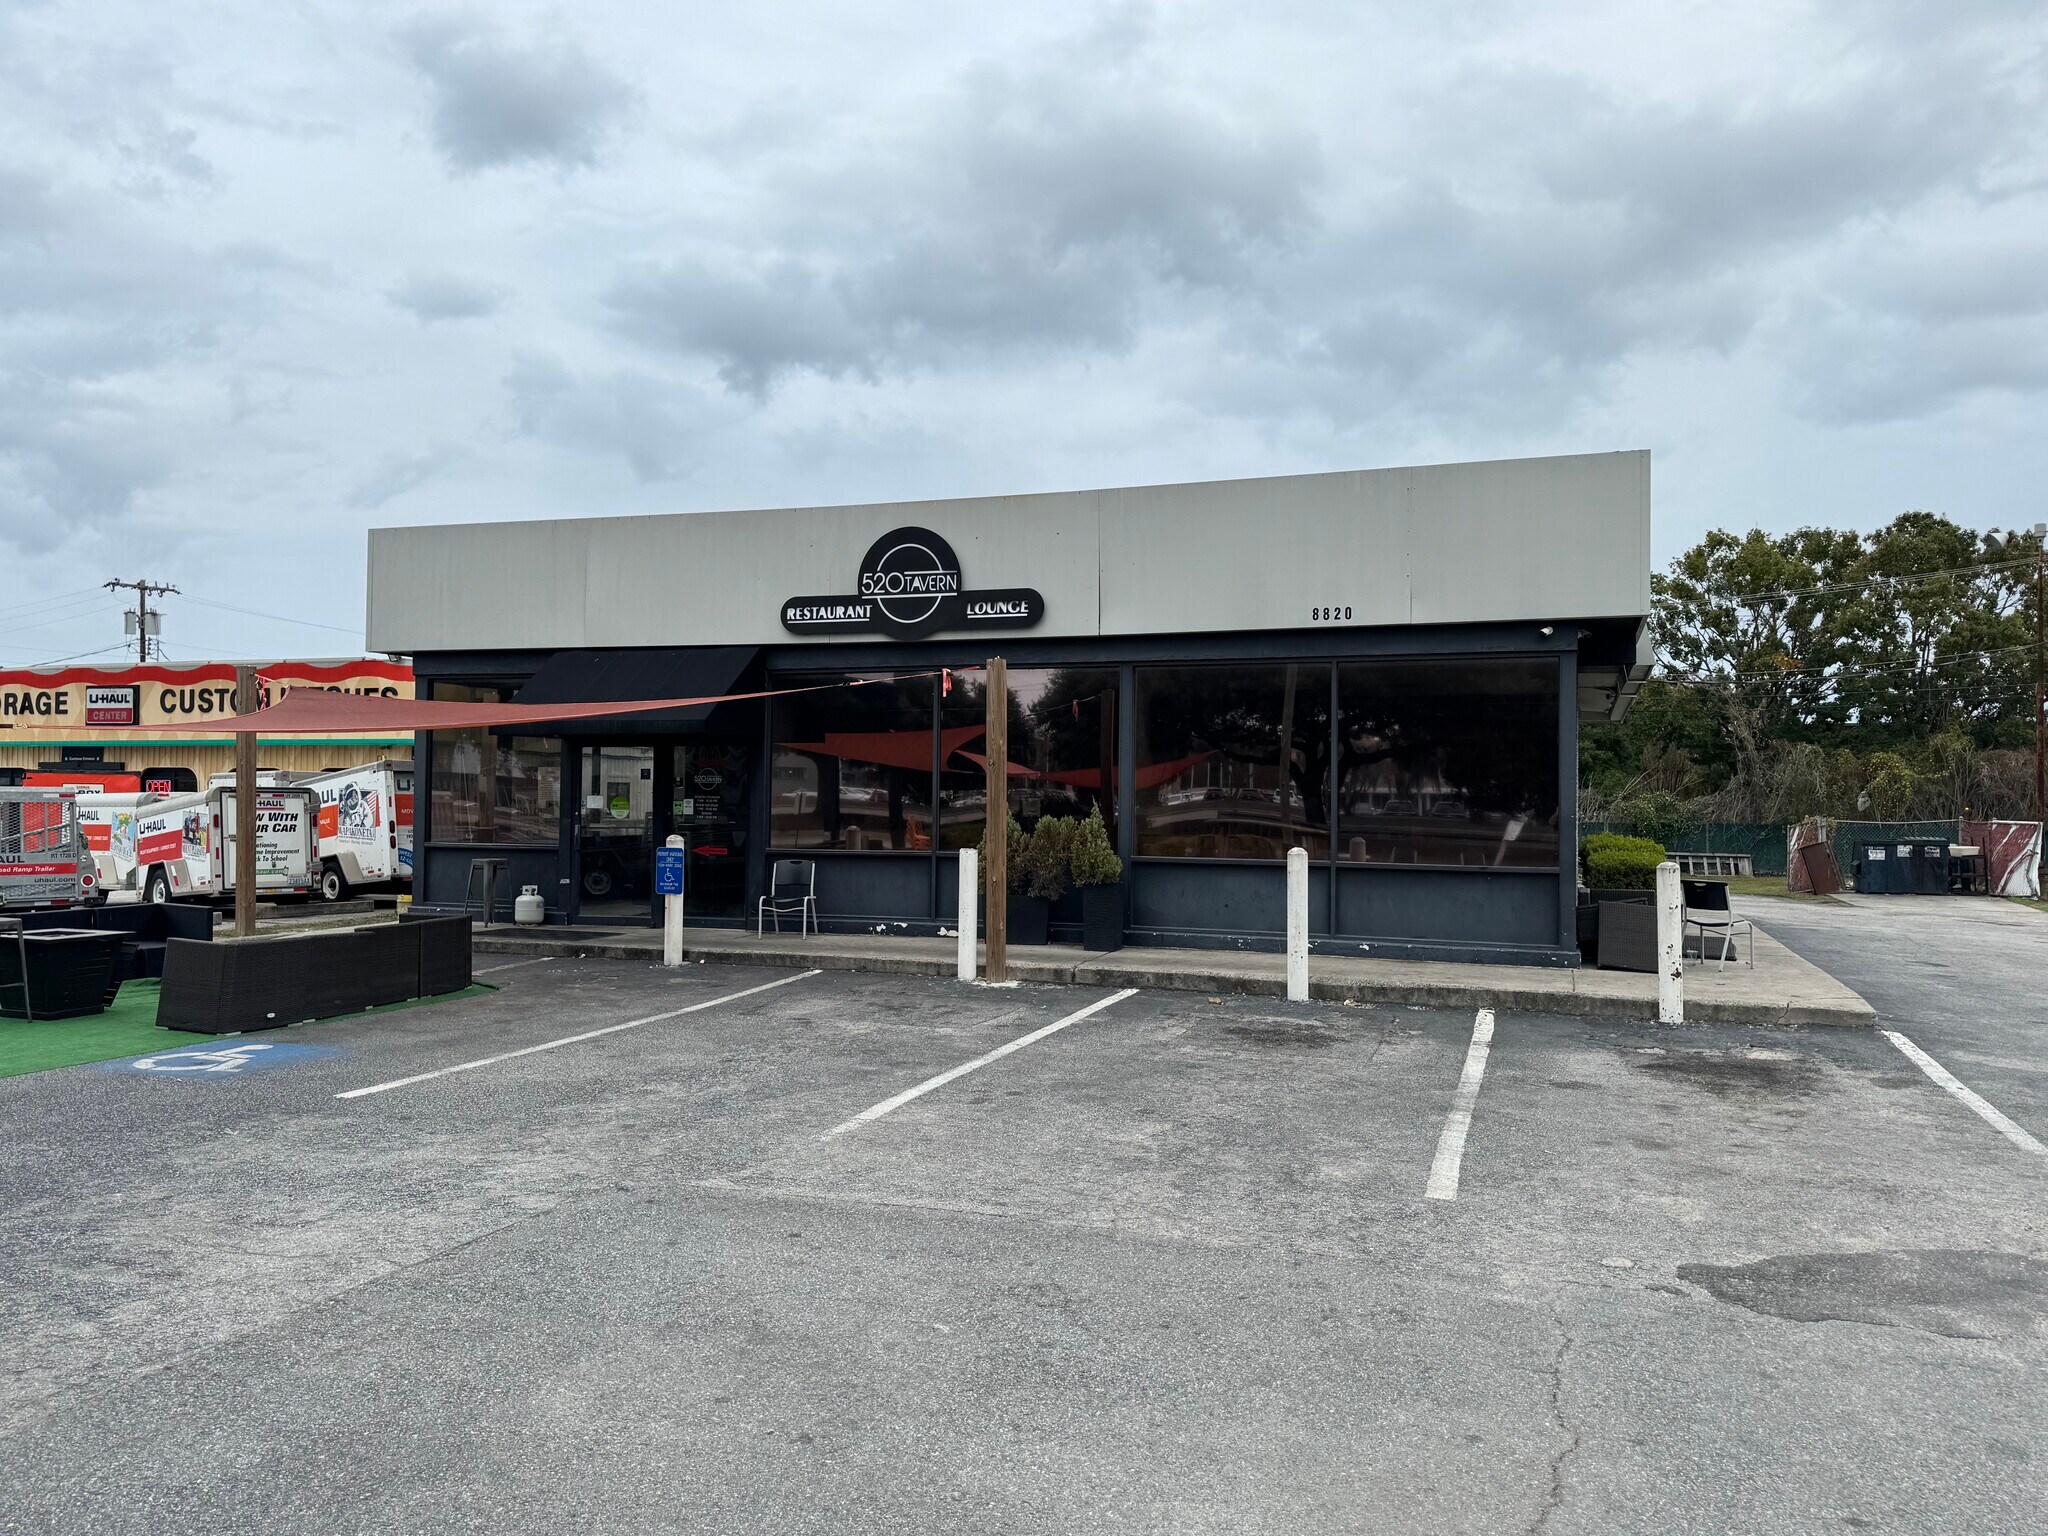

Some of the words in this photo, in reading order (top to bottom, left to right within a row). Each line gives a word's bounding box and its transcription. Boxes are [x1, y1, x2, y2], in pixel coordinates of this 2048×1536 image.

[787, 605, 873, 620] RESTAURANT
[966, 600, 1029, 615] LOUNGE
[1312, 606, 1352, 621] 8820
[0, 691, 69, 715] RAGE
[89, 693, 131, 704] U-HAUL
[93, 711, 127, 720] CENTER
[147, 781, 171, 792] OPEN
[268, 812, 298, 822] WITH
[139, 818, 166, 835] U-HAUL
[272, 824, 298, 833] CAR
[264, 848, 300, 856] Improvement
[0, 855, 25, 863] AUL
[12, 866, 33, 874] Ramp
